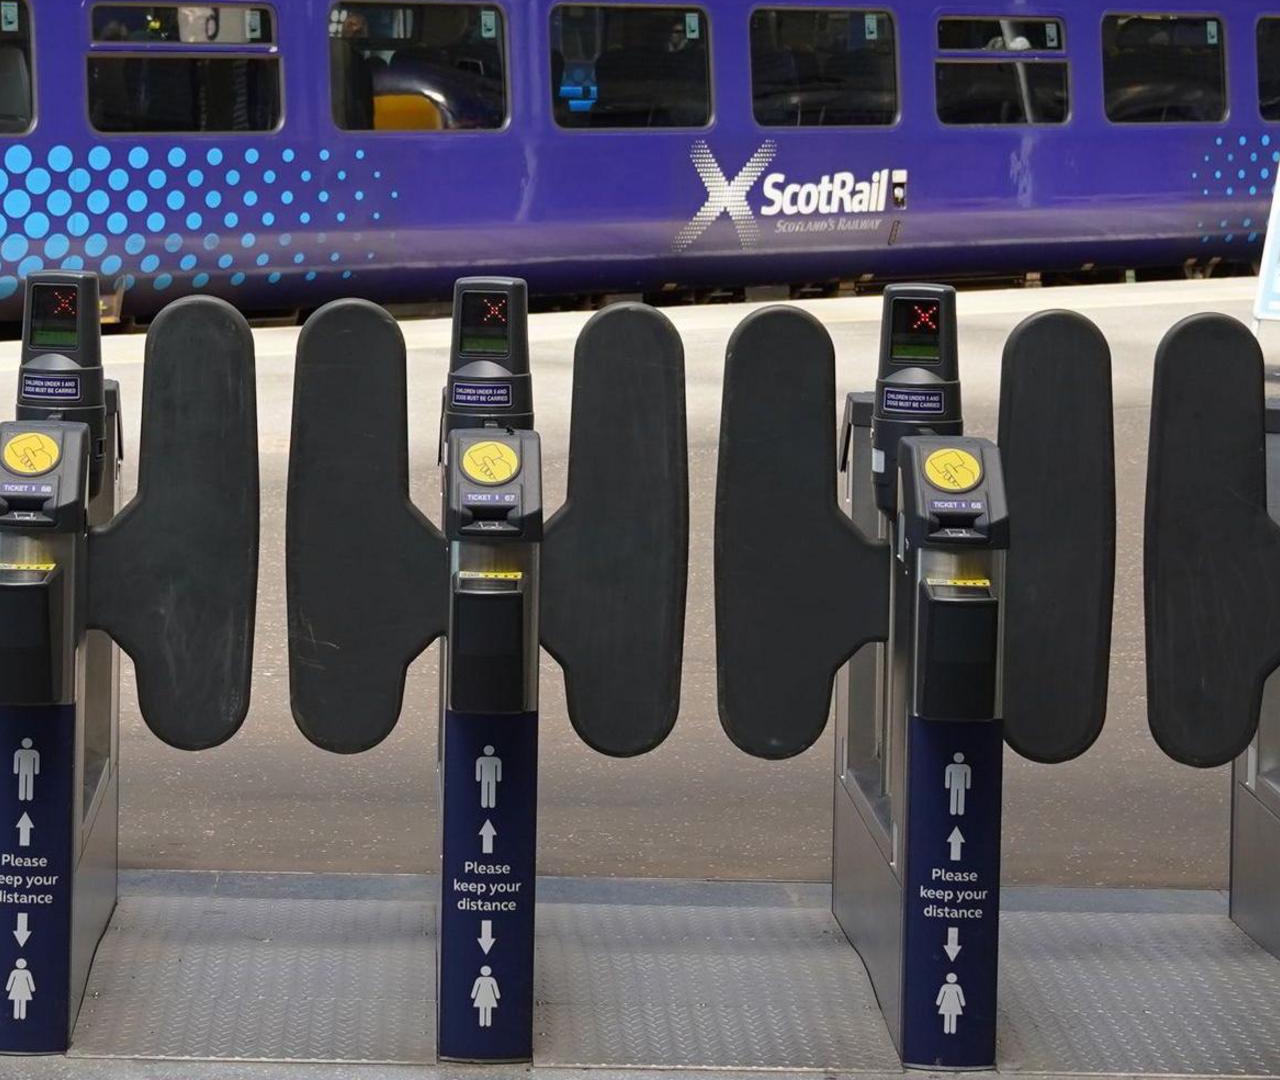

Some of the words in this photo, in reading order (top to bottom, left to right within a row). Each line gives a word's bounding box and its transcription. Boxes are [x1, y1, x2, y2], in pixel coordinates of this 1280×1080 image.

[760, 169, 890, 216] ScotRail
[505, 494, 515, 502] 67
[1, 853, 47, 867] Please
[464, 861, 511, 874] Please
[26, 875, 59, 888] your
[932, 868, 978, 882] Please
[453, 878, 485, 895] keep
[489, 882, 521, 896] your
[920, 885, 953, 902] keep
[956, 890, 988, 903] your
[457, 898, 516, 911] distance
[924, 905, 983, 919] distance
